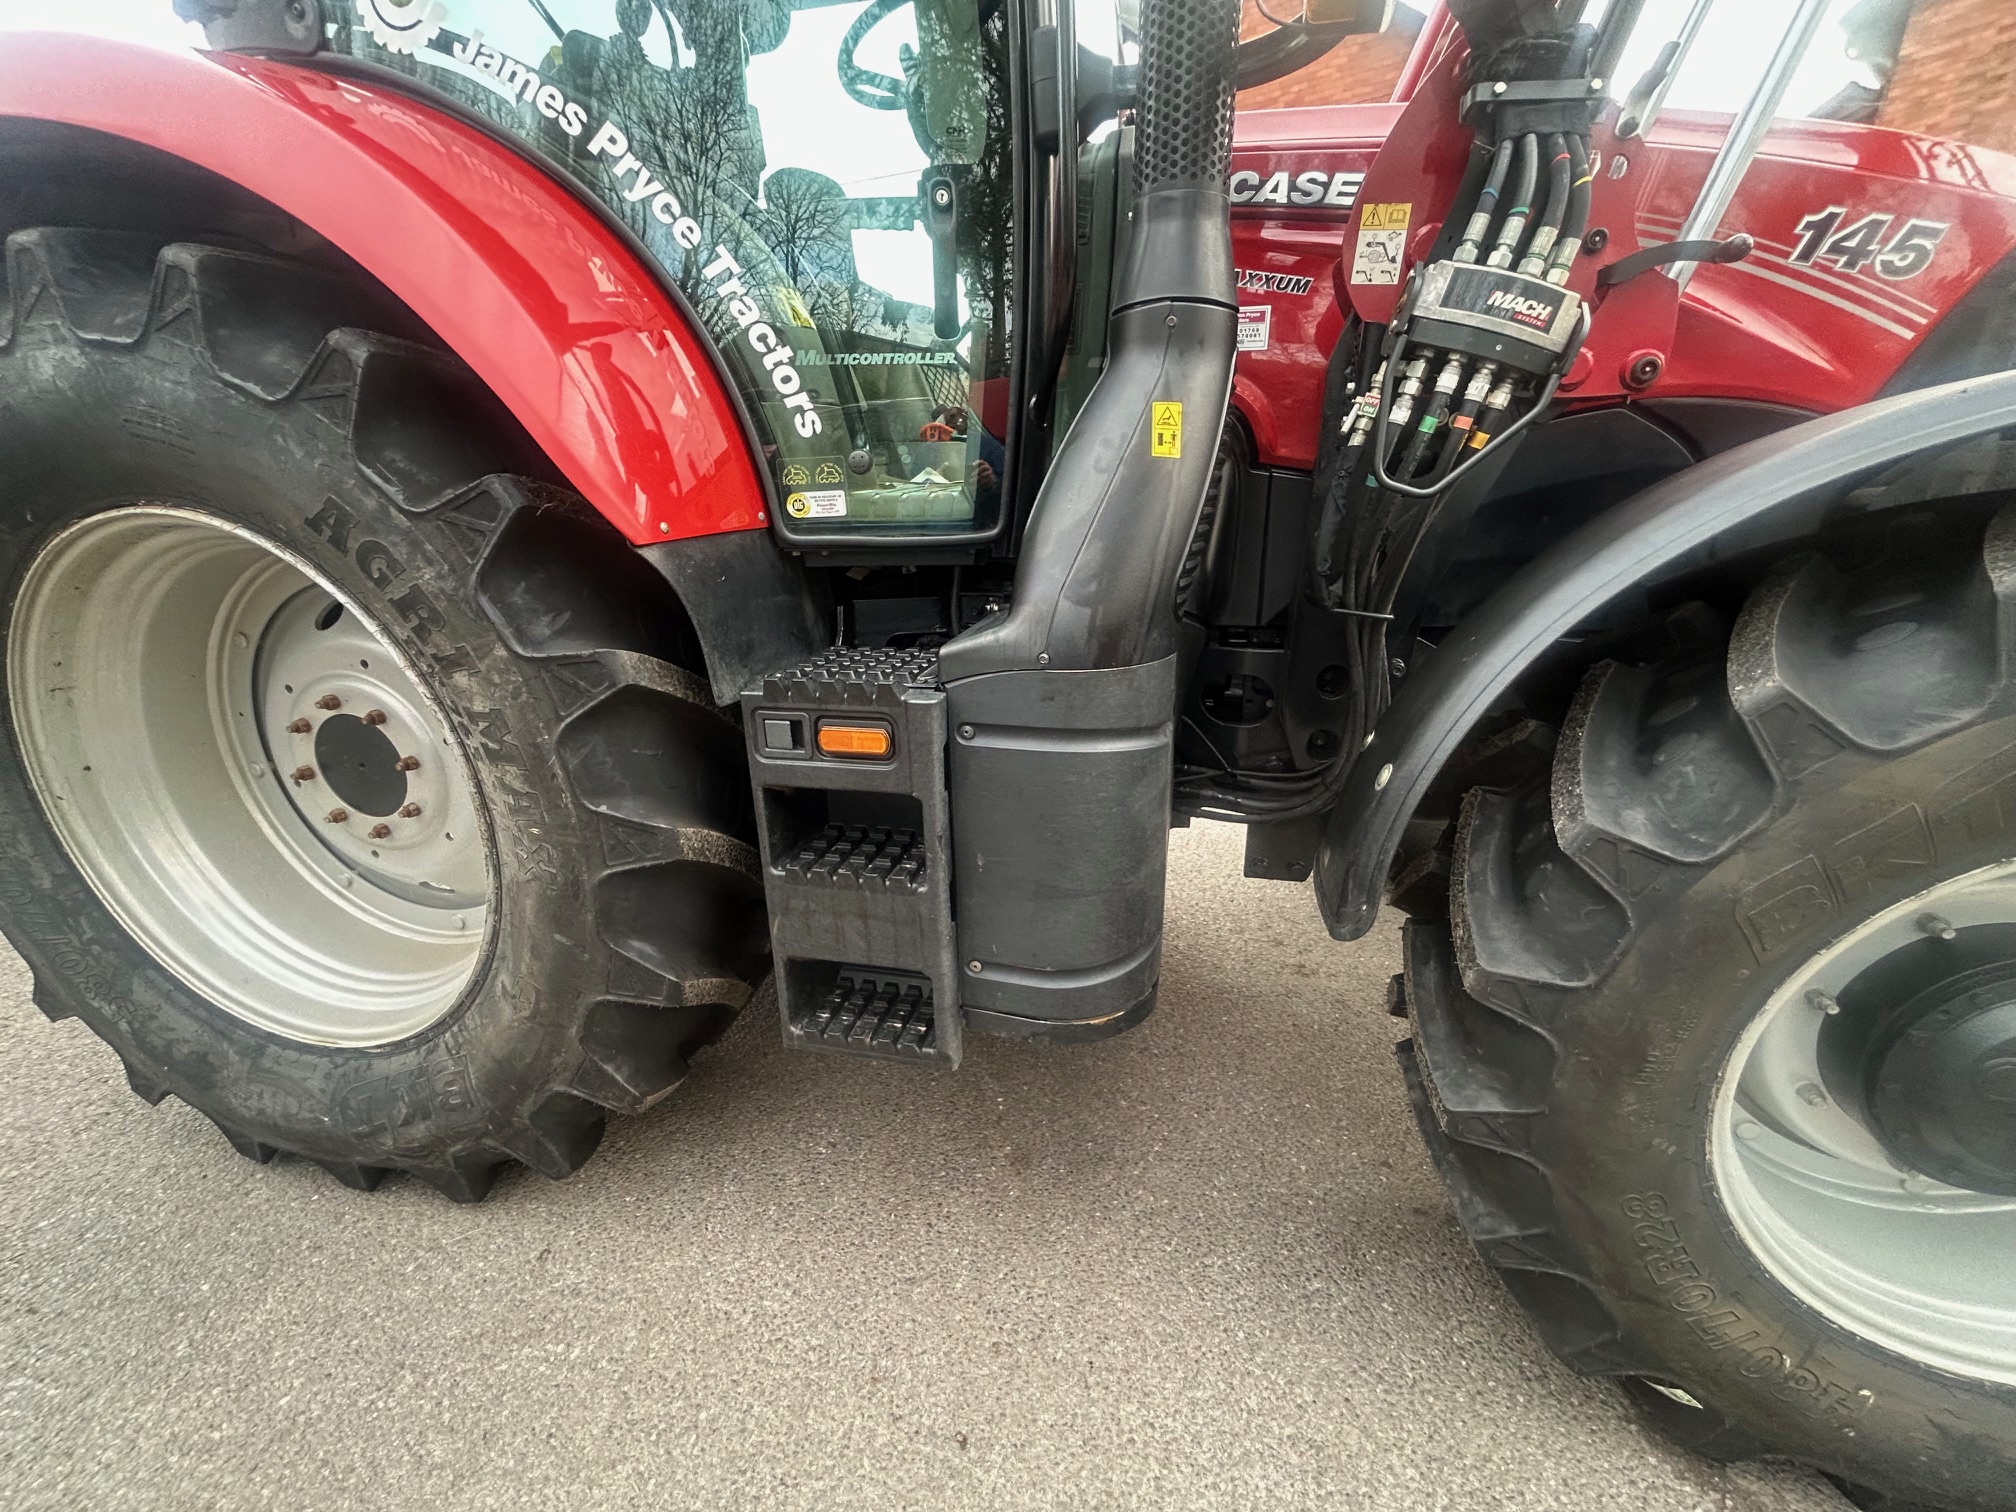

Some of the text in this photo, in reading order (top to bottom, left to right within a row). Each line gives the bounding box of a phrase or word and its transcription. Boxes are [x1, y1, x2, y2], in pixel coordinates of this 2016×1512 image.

[1230, 171, 1366, 205] CASE
[452, 28, 822, 439] James Pryce Tractors
[1787, 204, 1951, 279] 145
[1487, 290, 1553, 320] MACH
[1517, 314, 1542, 327] SYSTEM
[1363, 406, 1374, 414] ON
[1365, 397, 1379, 406] OFF
[0, 866, 137, 1024] 580/70
